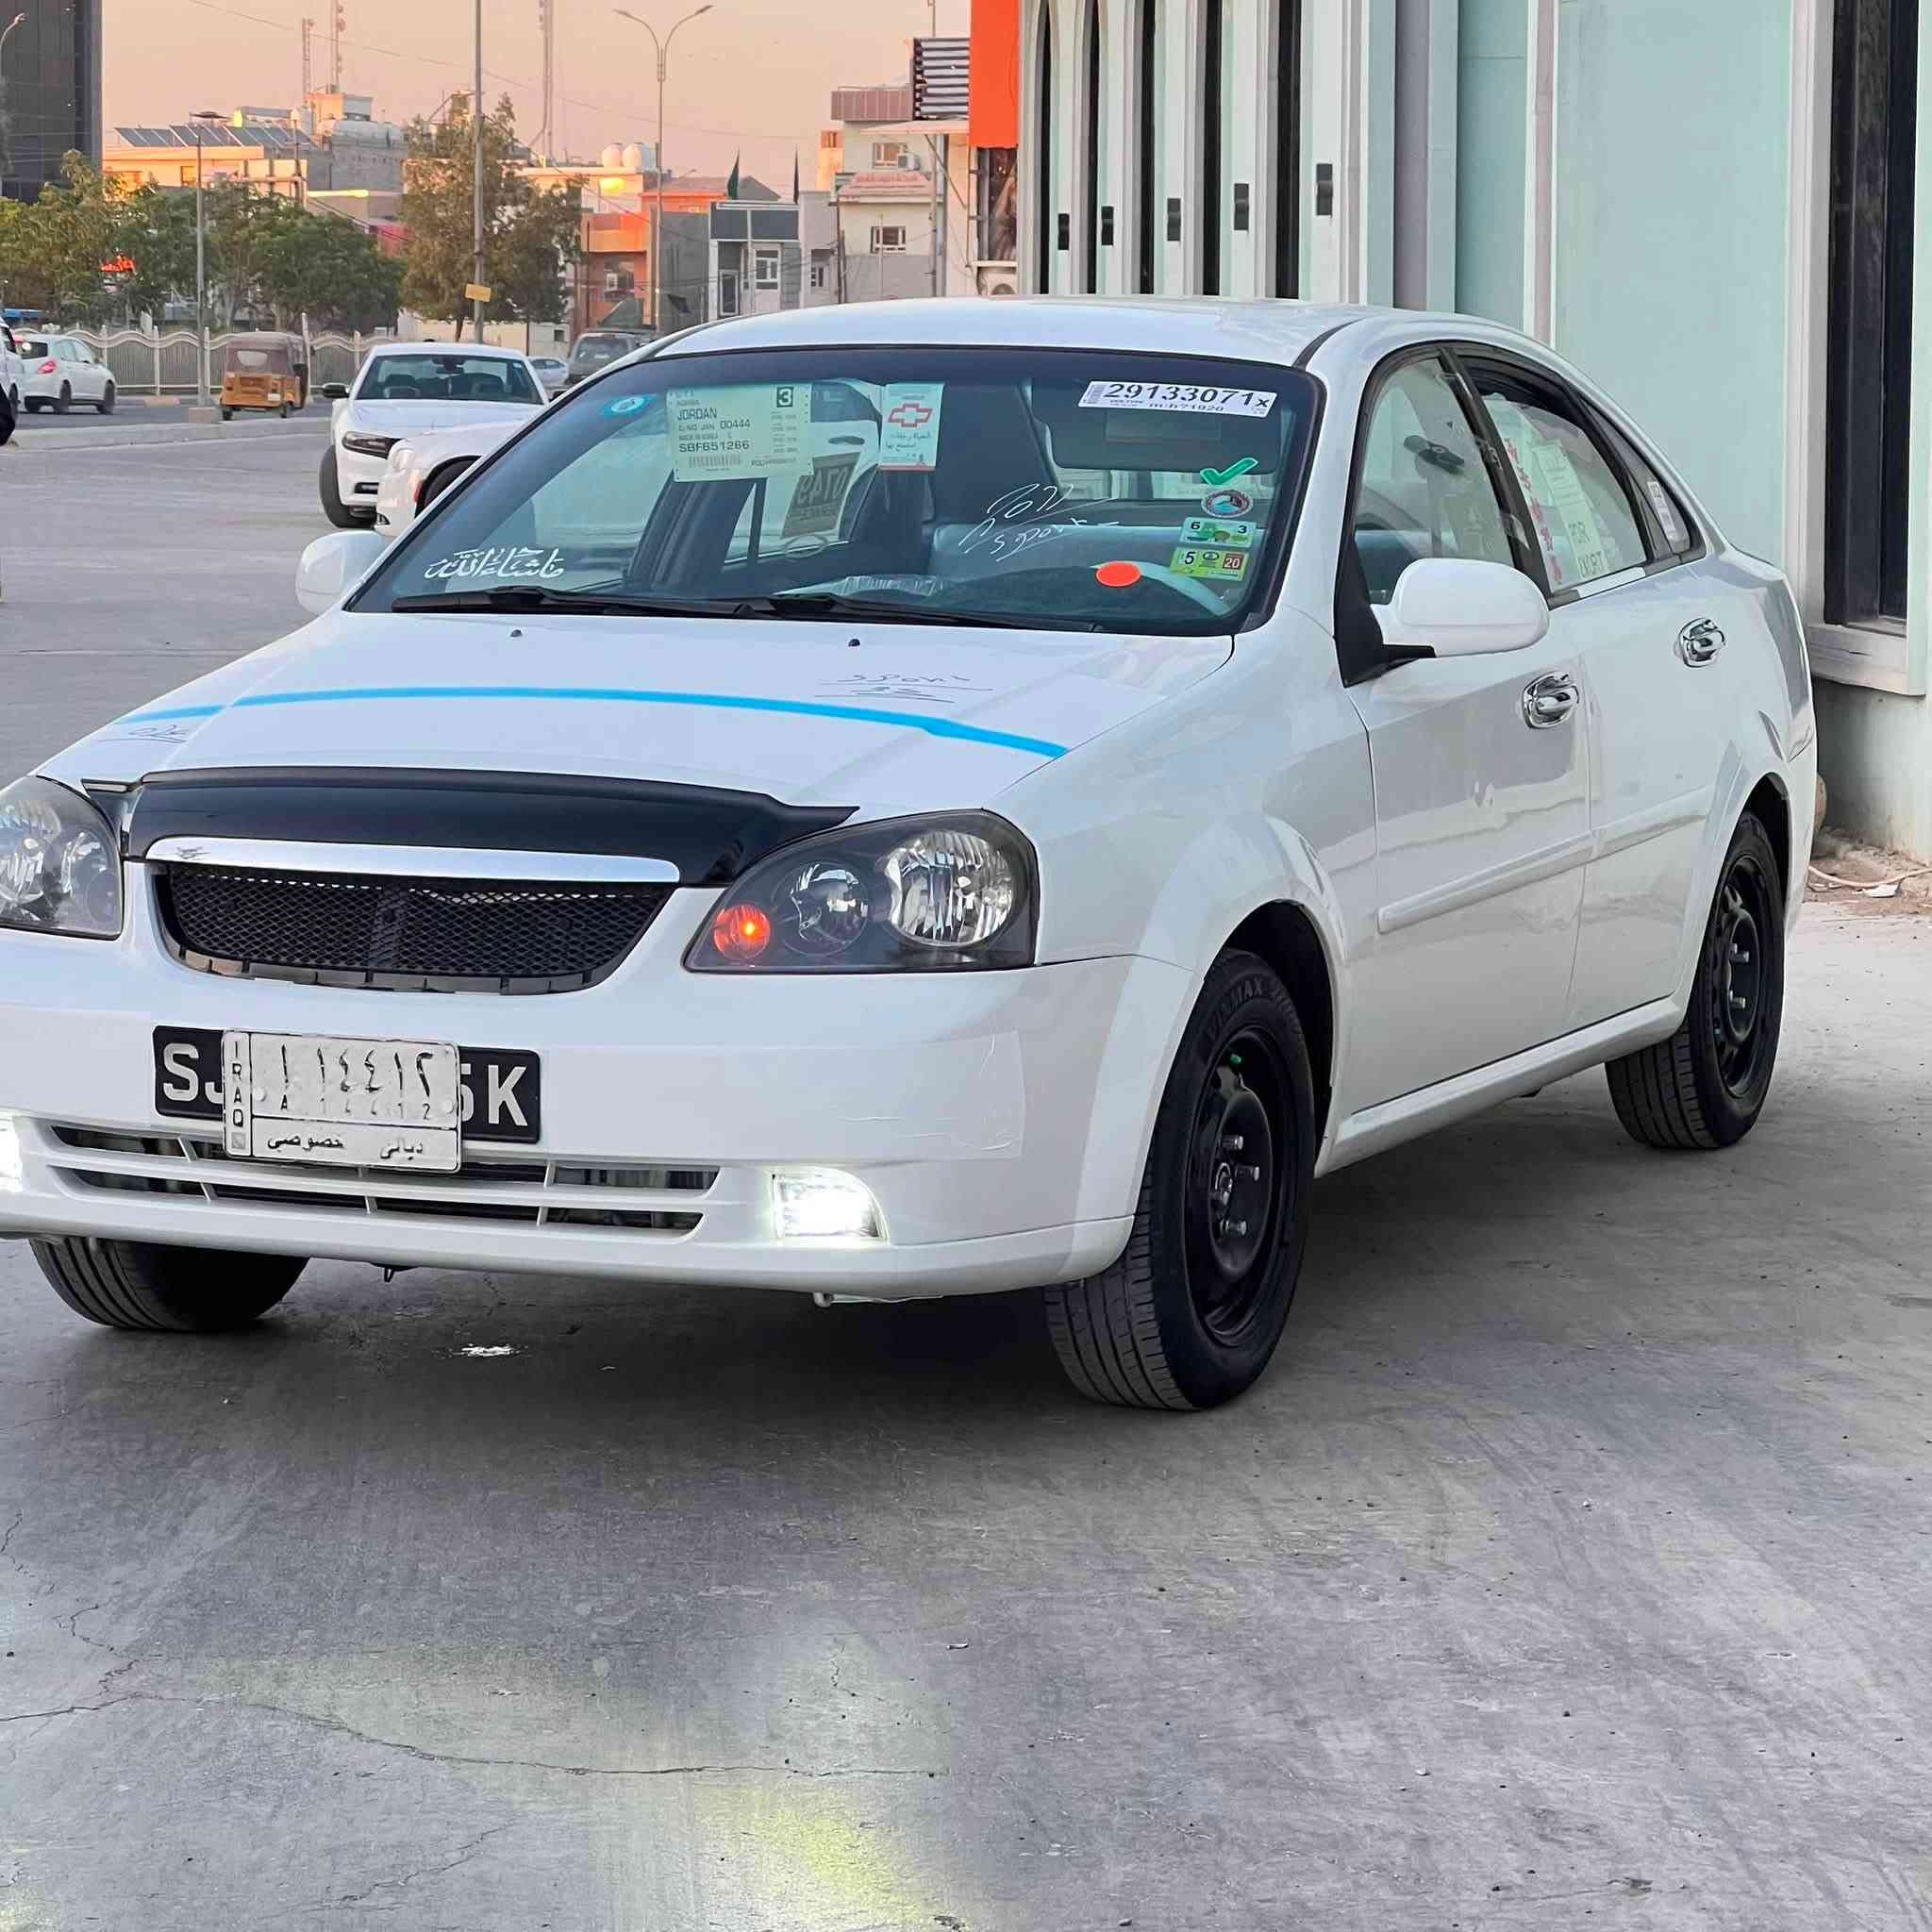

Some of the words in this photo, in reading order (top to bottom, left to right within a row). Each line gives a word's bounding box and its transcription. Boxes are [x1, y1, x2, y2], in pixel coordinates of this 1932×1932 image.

[778, 388, 792, 406] 3
[677, 408, 717, 421] JORDAN
[1191, 522, 1201, 530] 6
[1238, 525, 1247, 534] 3
[1184, 551, 1196, 565] 5
[1224, 558, 1241, 569] 20
[231, 1041, 244, 1128] IRAQ
